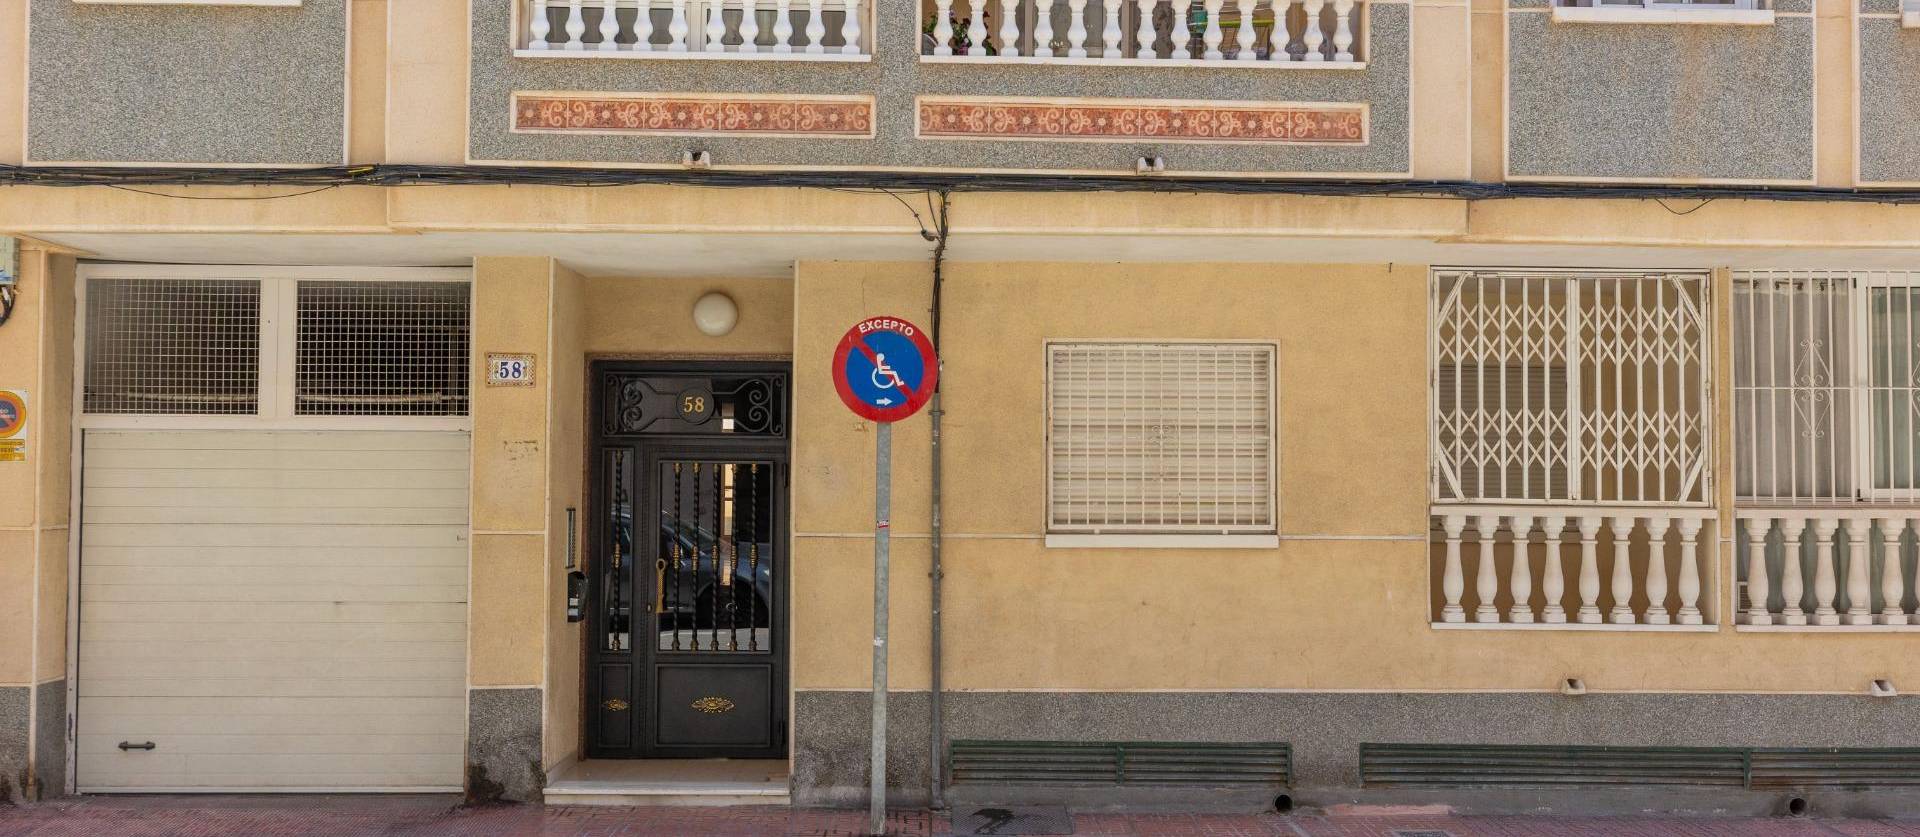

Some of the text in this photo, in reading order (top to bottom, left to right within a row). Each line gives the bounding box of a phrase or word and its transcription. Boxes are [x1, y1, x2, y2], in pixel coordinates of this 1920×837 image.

[859, 319, 914, 337] EXCEPTO
[500, 362, 522, 379] 58
[683, 397, 705, 413] 58
